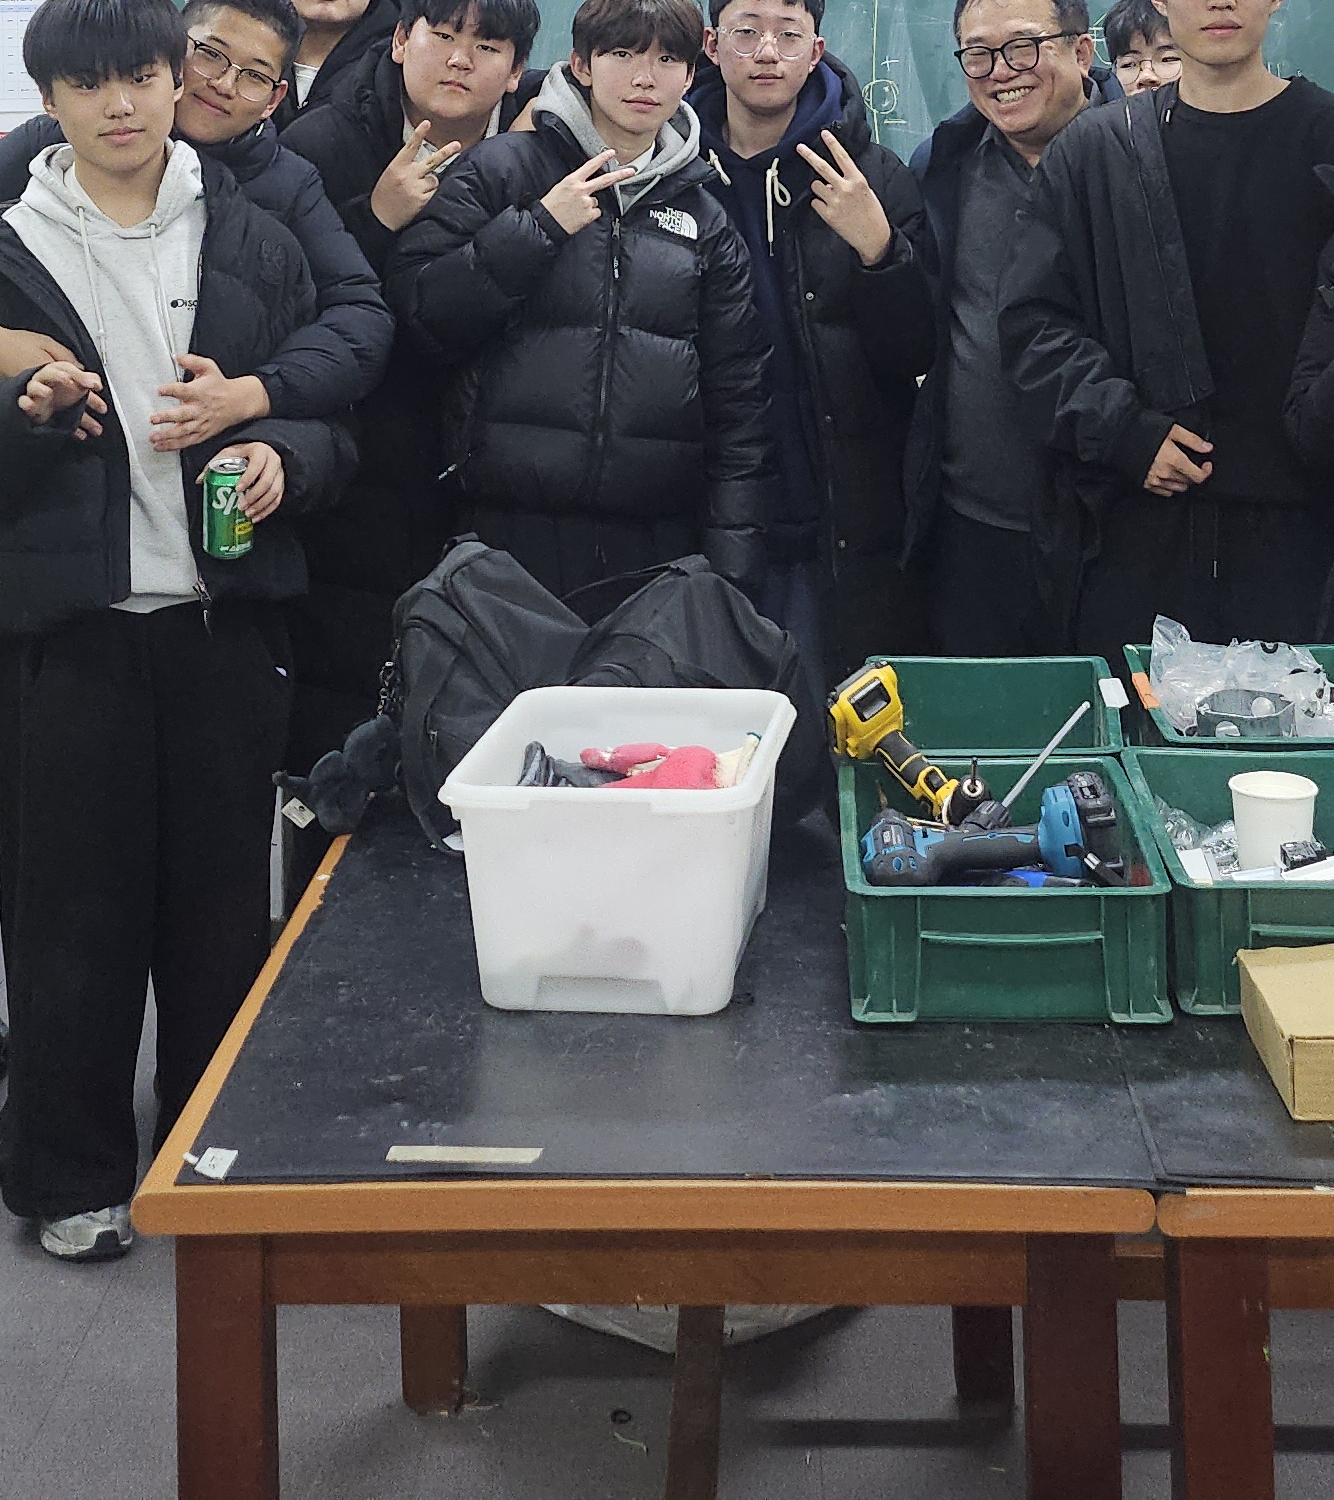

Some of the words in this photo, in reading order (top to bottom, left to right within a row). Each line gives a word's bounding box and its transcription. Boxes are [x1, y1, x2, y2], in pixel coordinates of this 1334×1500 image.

[650, 209, 682, 227] NORTH
[665, 206, 683, 218] THE
[658, 220, 682, 234] FACE
